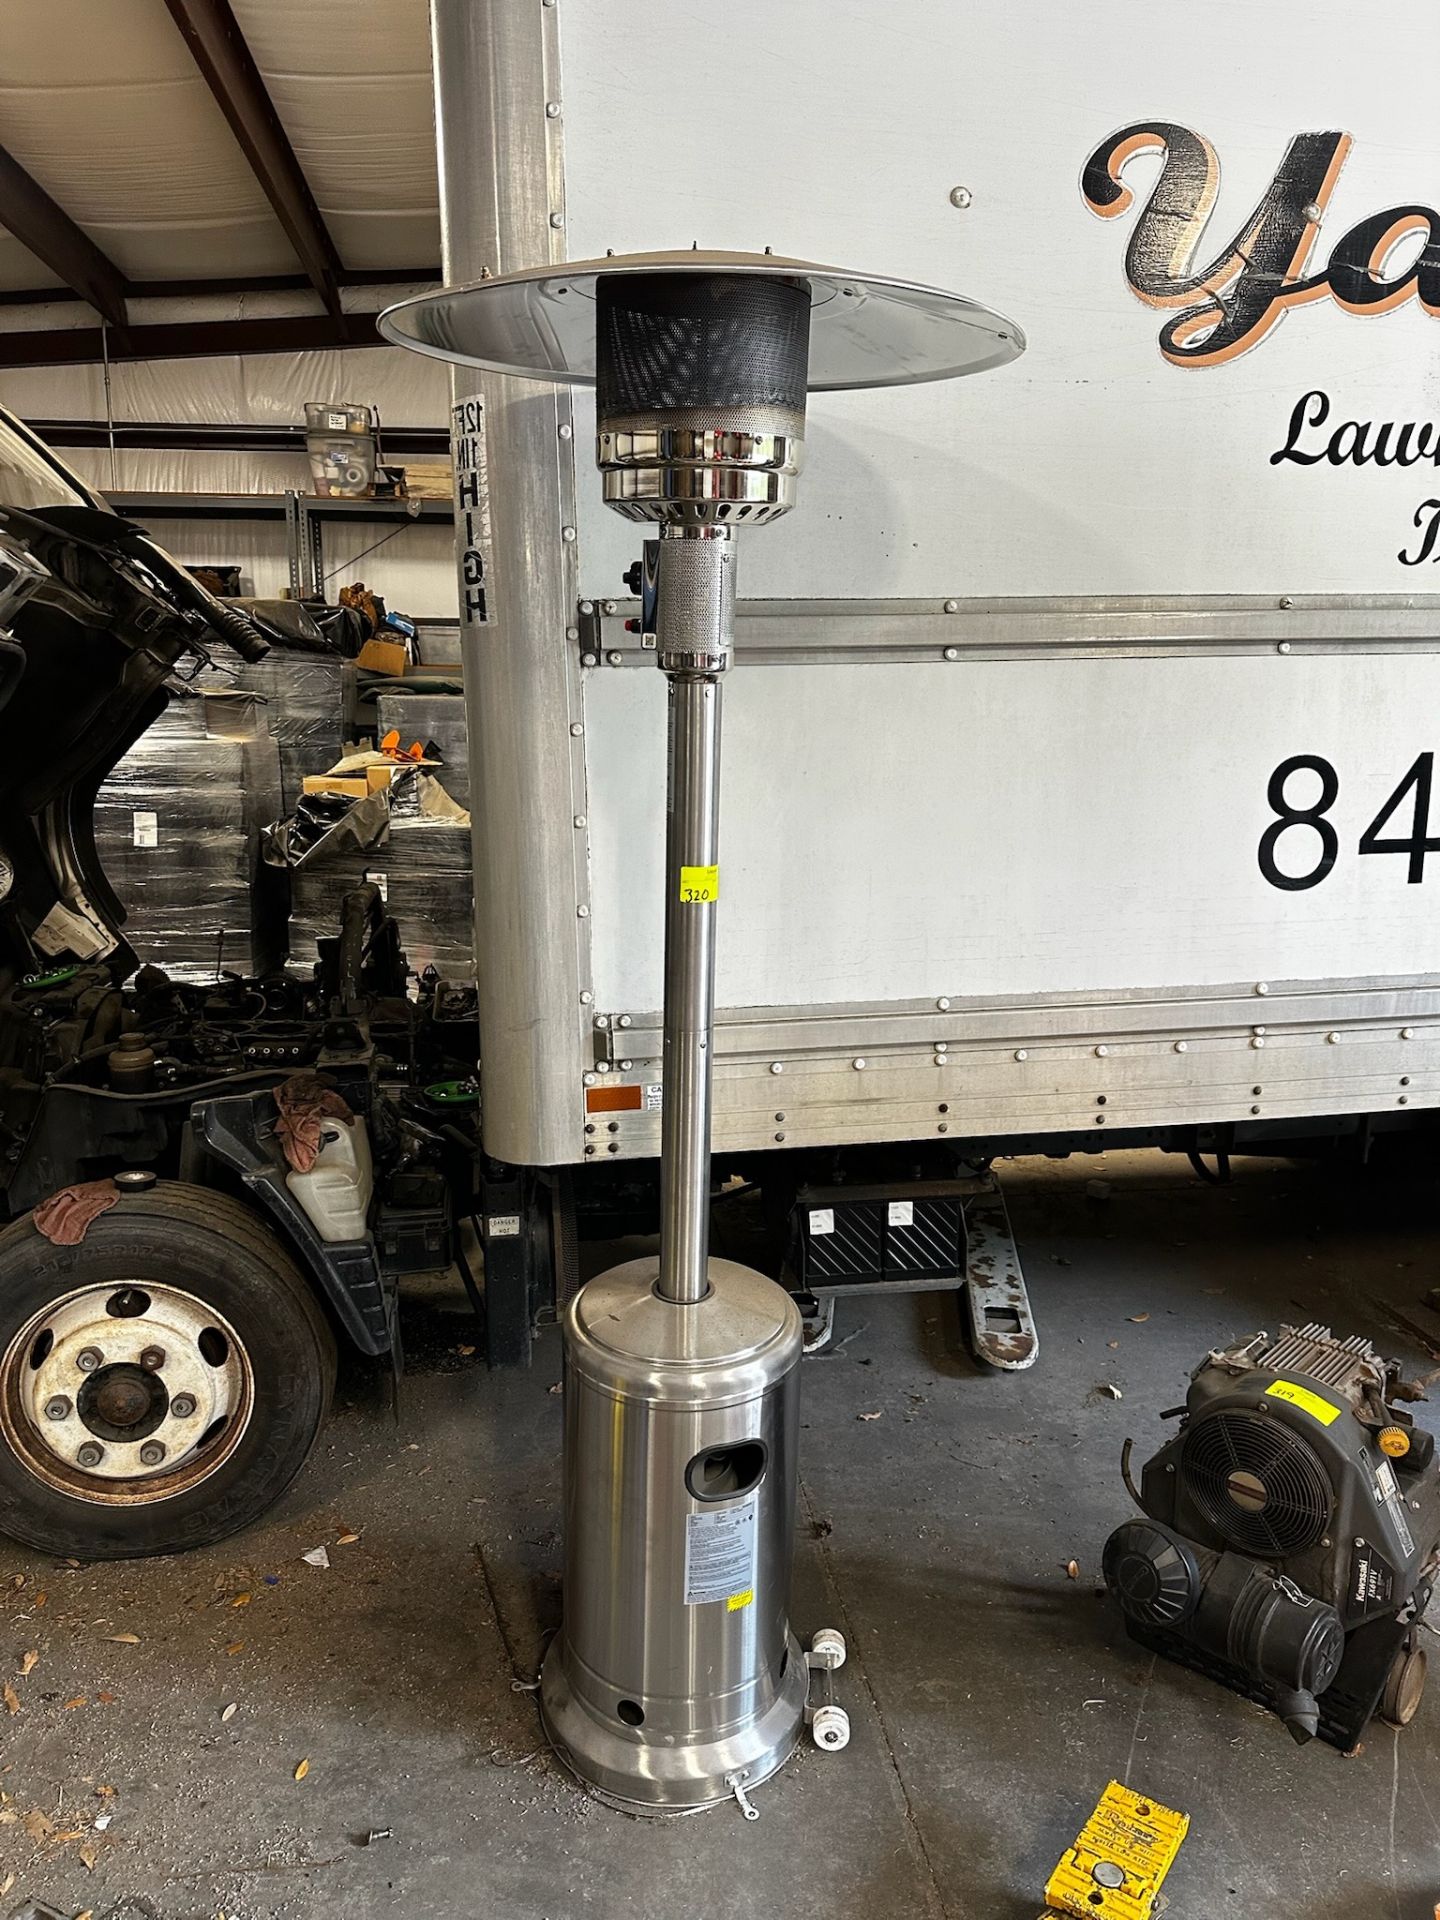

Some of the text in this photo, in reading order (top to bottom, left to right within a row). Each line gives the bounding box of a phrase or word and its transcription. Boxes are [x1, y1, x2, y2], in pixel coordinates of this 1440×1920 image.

[1270, 390, 1440, 466] Law
[1258, 752, 1440, 892] 84
[684, 889, 709, 903] 320
[1355, 1559, 1368, 1602] Kawasaki
